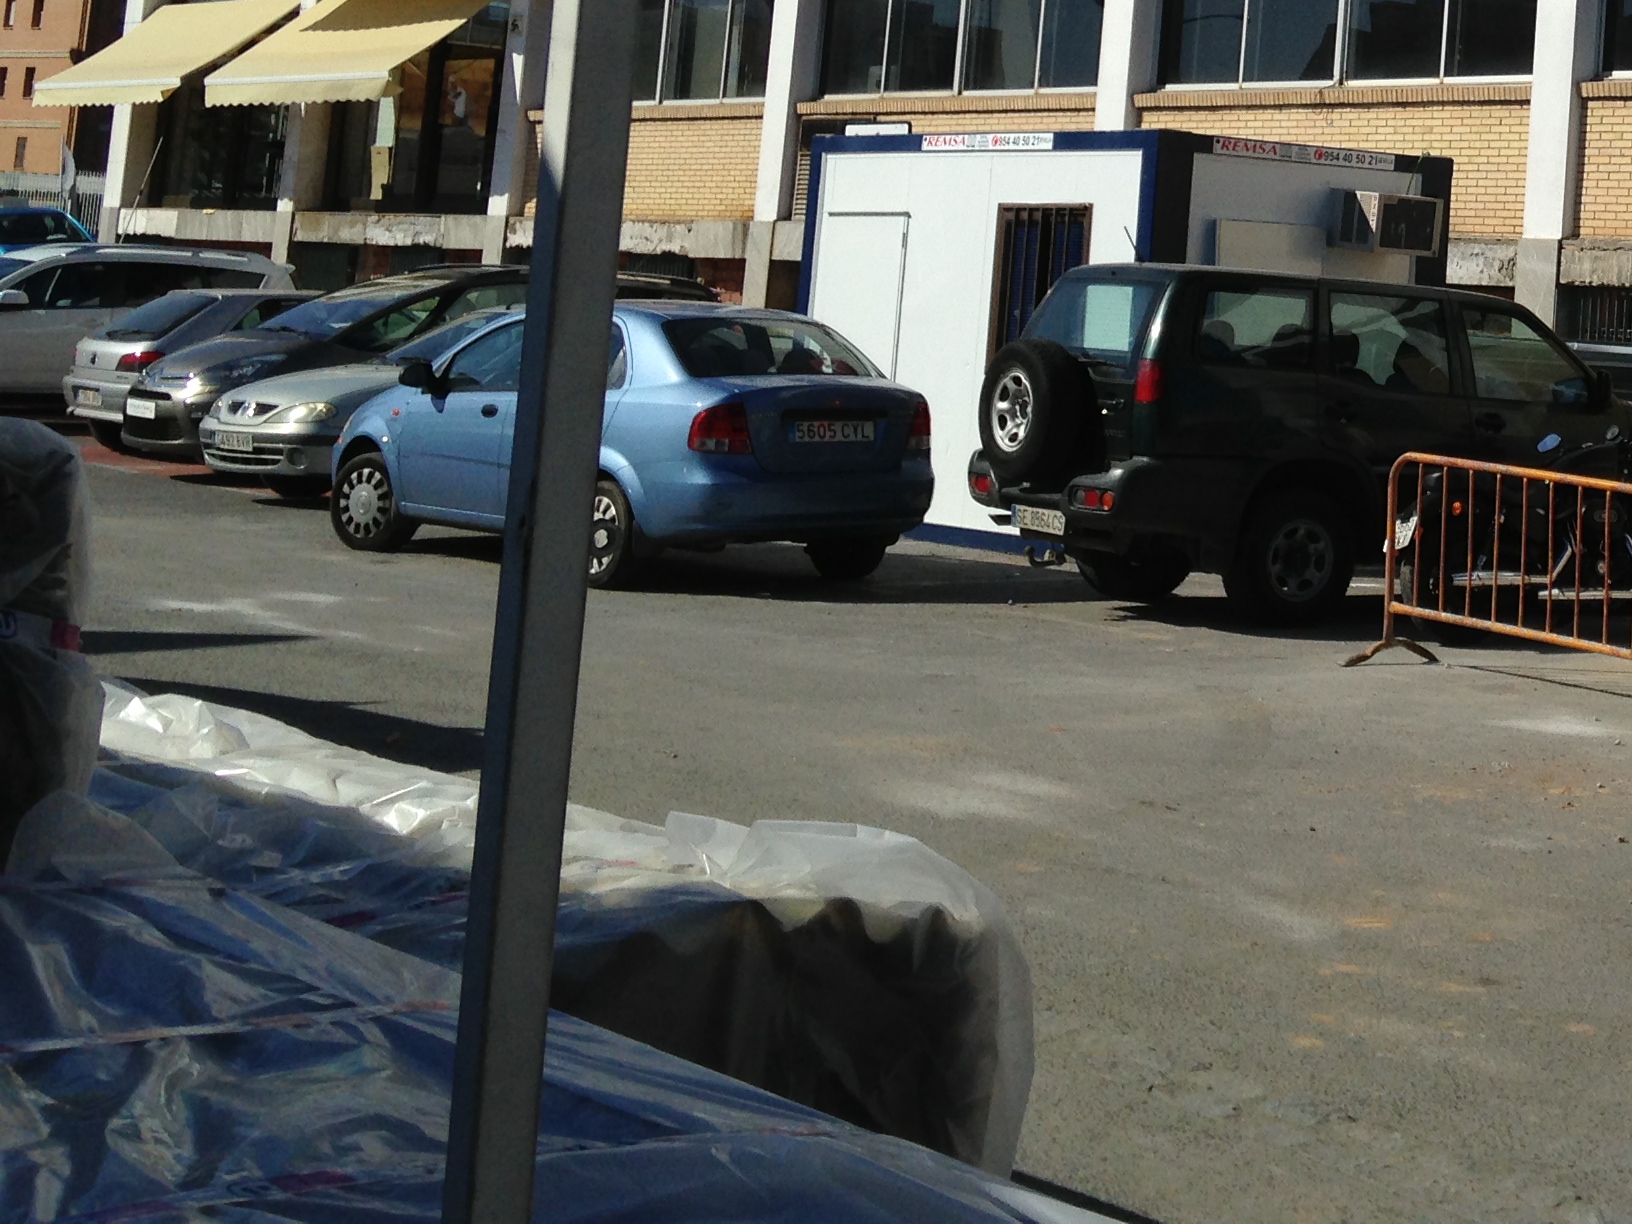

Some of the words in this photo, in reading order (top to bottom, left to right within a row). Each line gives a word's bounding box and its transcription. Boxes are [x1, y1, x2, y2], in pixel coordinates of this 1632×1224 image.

[926, 135, 966, 147] REMSA
[1220, 139, 1278, 156] REMSA
[1324, 150, 1340, 162] 954
[1342, 152, 1353, 164] 40
[1355, 153, 1366, 165] 50
[1367, 154, 1378, 166] 21
[796, 423, 837, 439] 5605
[841, 423, 869, 439] CYL
